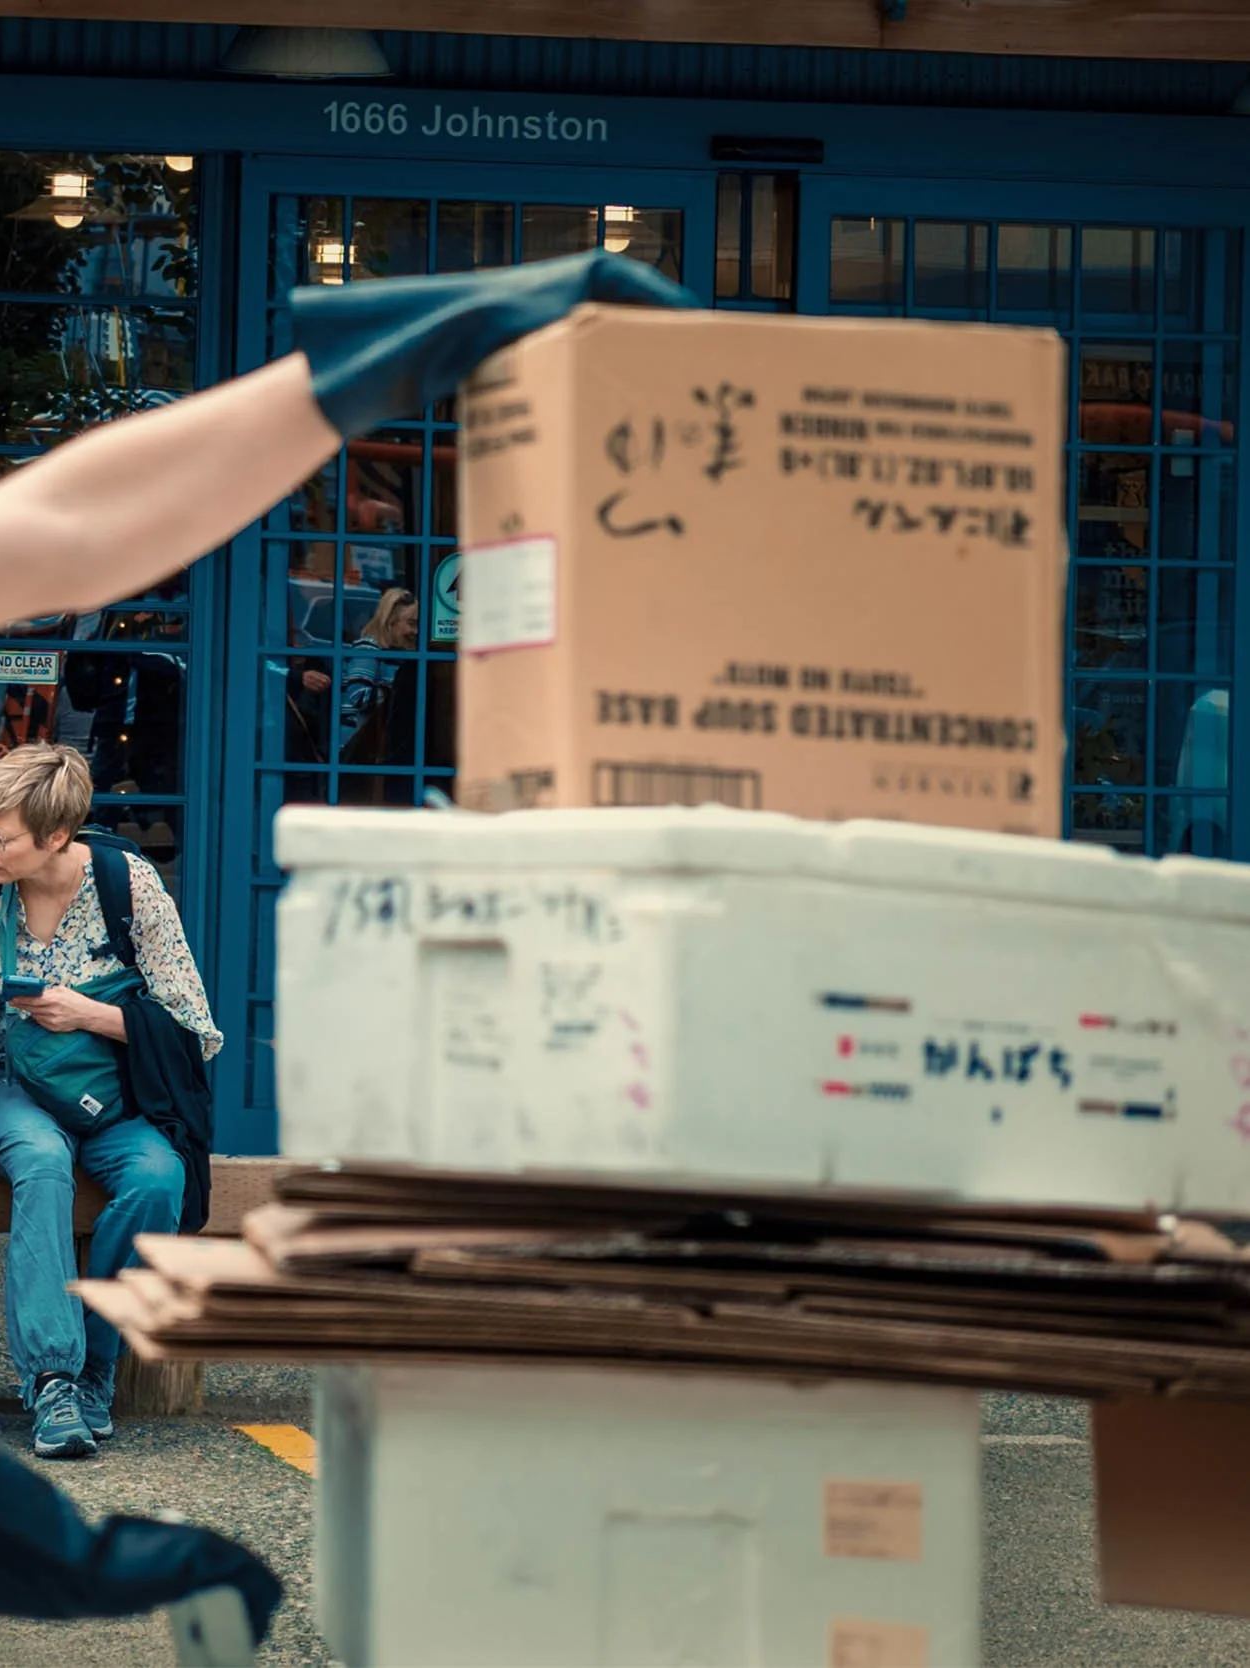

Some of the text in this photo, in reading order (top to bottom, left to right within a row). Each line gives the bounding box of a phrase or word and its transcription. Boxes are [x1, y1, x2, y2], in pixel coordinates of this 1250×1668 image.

[322, 101, 609, 142] 1666 Johnston
[14, 656, 52, 668] CLEAR
[596, 690, 1037, 752] CONCENTRATED SOUP BASE
